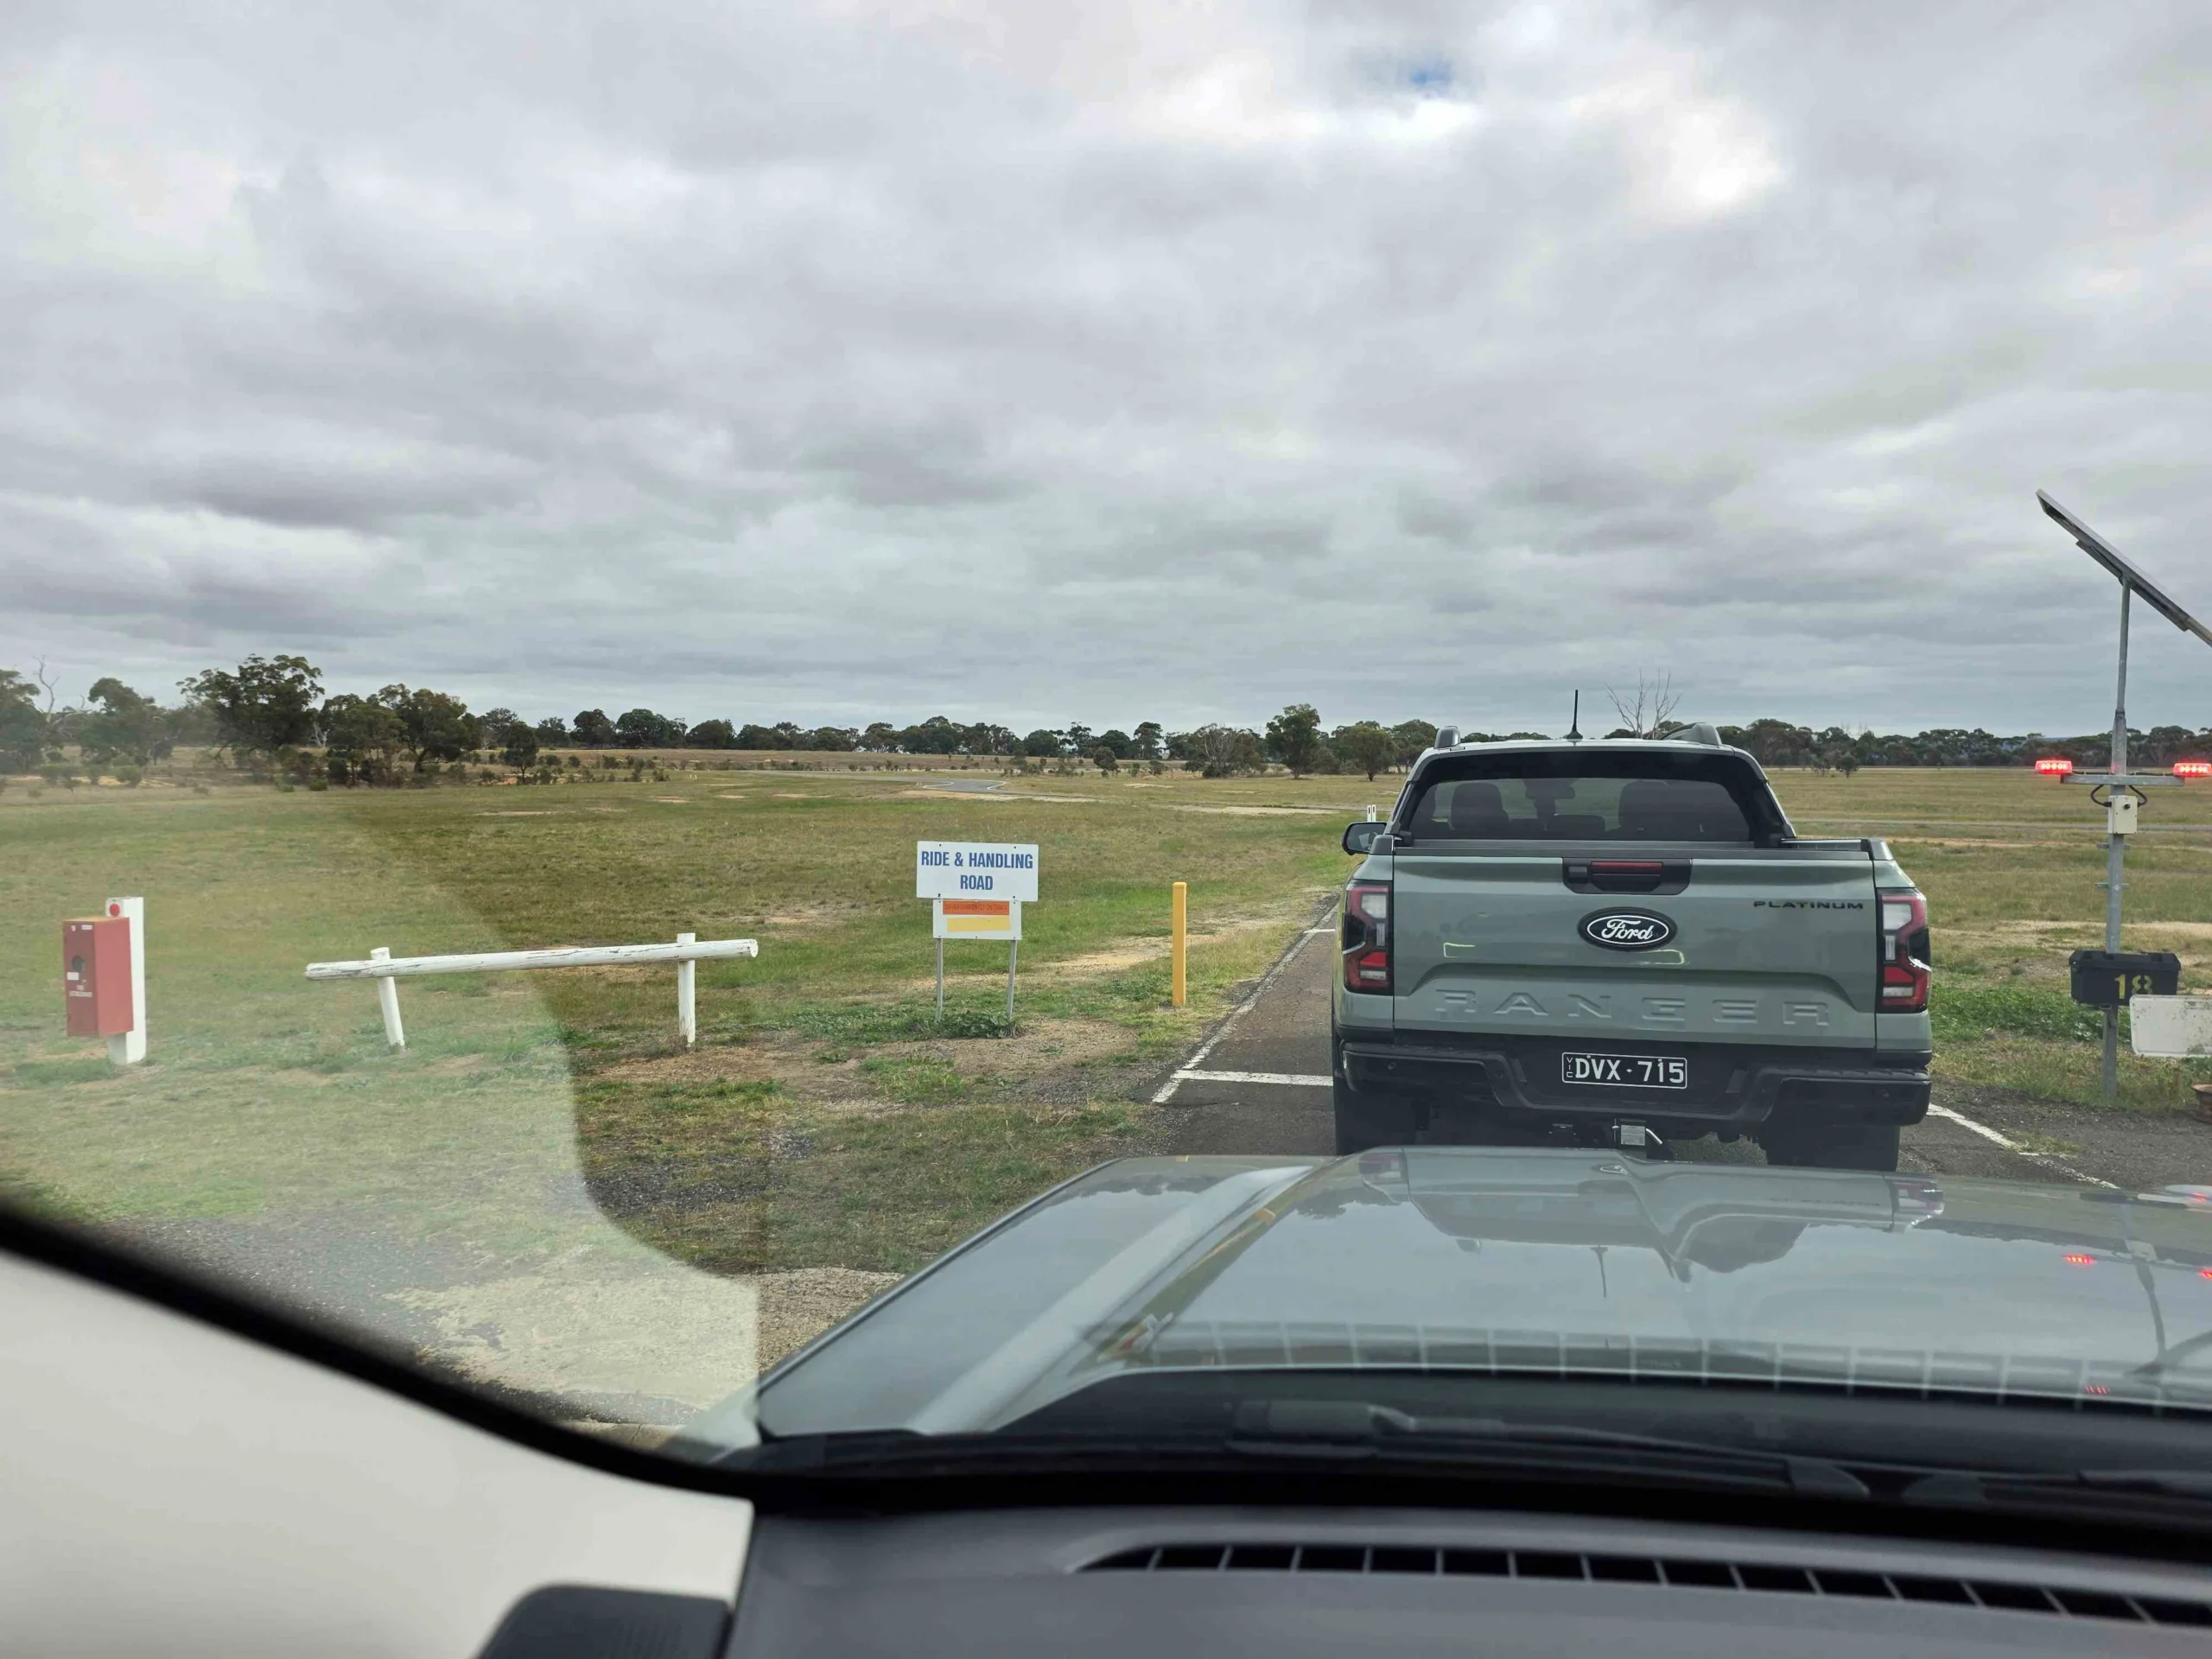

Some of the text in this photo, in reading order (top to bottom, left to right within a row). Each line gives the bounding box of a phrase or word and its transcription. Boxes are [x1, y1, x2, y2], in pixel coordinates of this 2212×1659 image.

[921, 851, 1033, 869] RIDE & HANDLING
[960, 874, 994, 890] ROAD
[1753, 900, 1864, 910] PLATINUM
[1601, 918, 1654, 941] Ford
[2114, 974, 2153, 1000] 18
[1435, 988, 1829, 1026] RANGER
